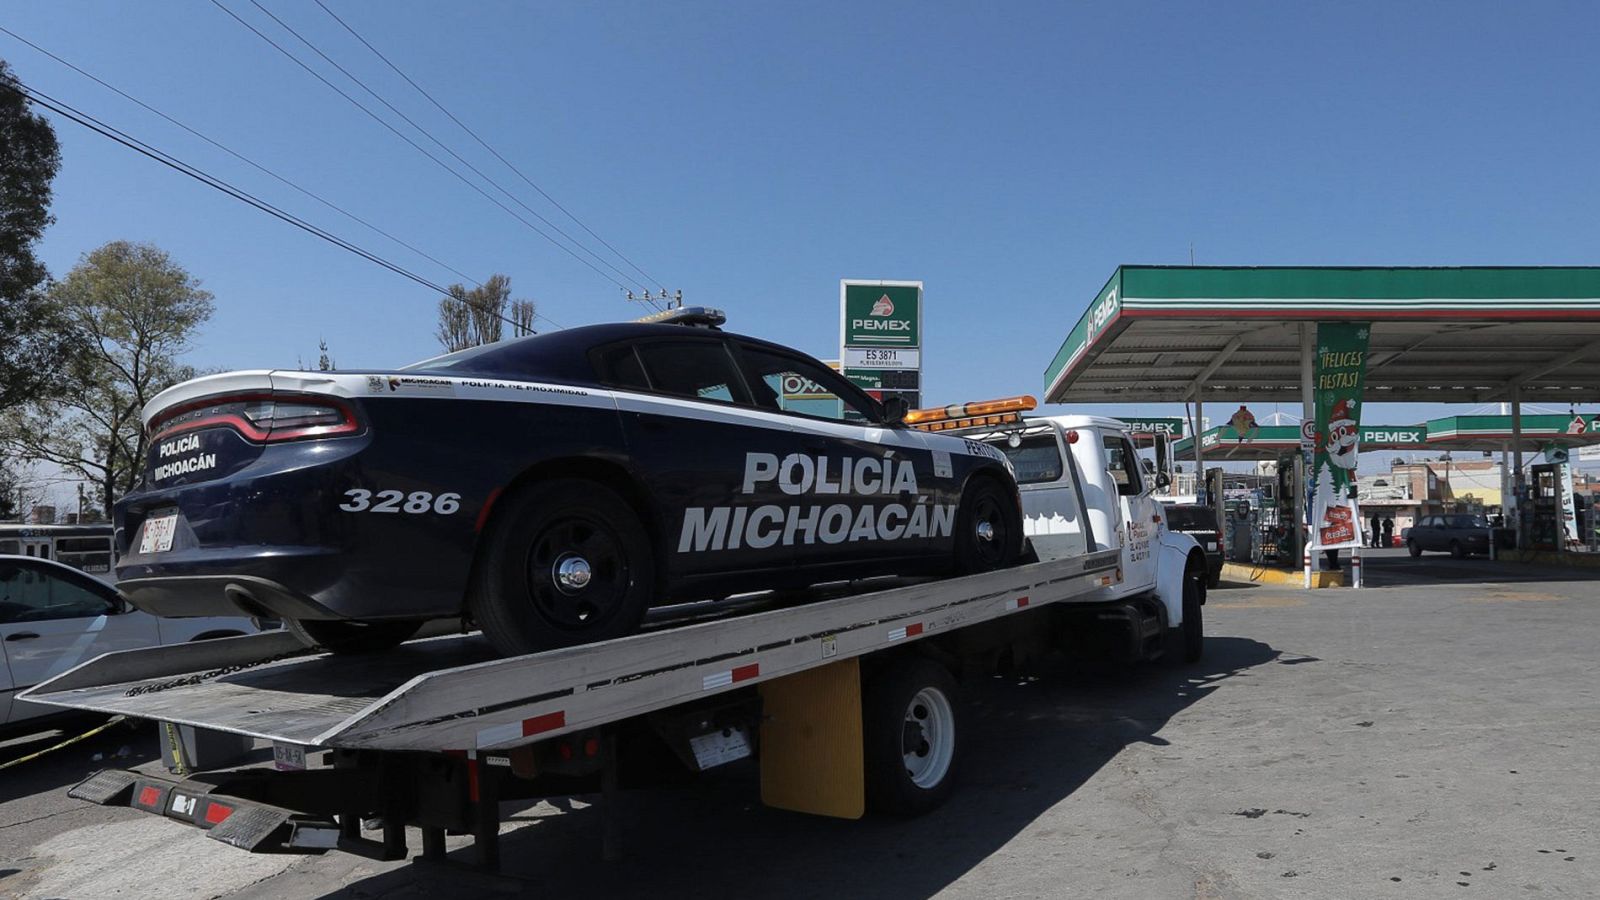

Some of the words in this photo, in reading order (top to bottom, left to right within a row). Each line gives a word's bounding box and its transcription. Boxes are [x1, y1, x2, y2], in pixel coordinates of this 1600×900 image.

[853, 319, 910, 331] PEMEX
[866, 350, 877, 360] ES
[879, 350, 897, 360] 3871
[1322, 351, 1363, 369] ¡FELICES
[1319, 371, 1359, 390] FIESTAS!
[160, 433, 200, 458] POLICÍA
[1202, 433, 1218, 447] PEMEX
[1365, 432, 1419, 442] PEMEX
[154, 453, 216, 481] MICHOACÁN
[741, 451, 918, 495] POLICÍA
[339, 488, 462, 515] 3286
[677, 495, 955, 553] MICHOACÁN
